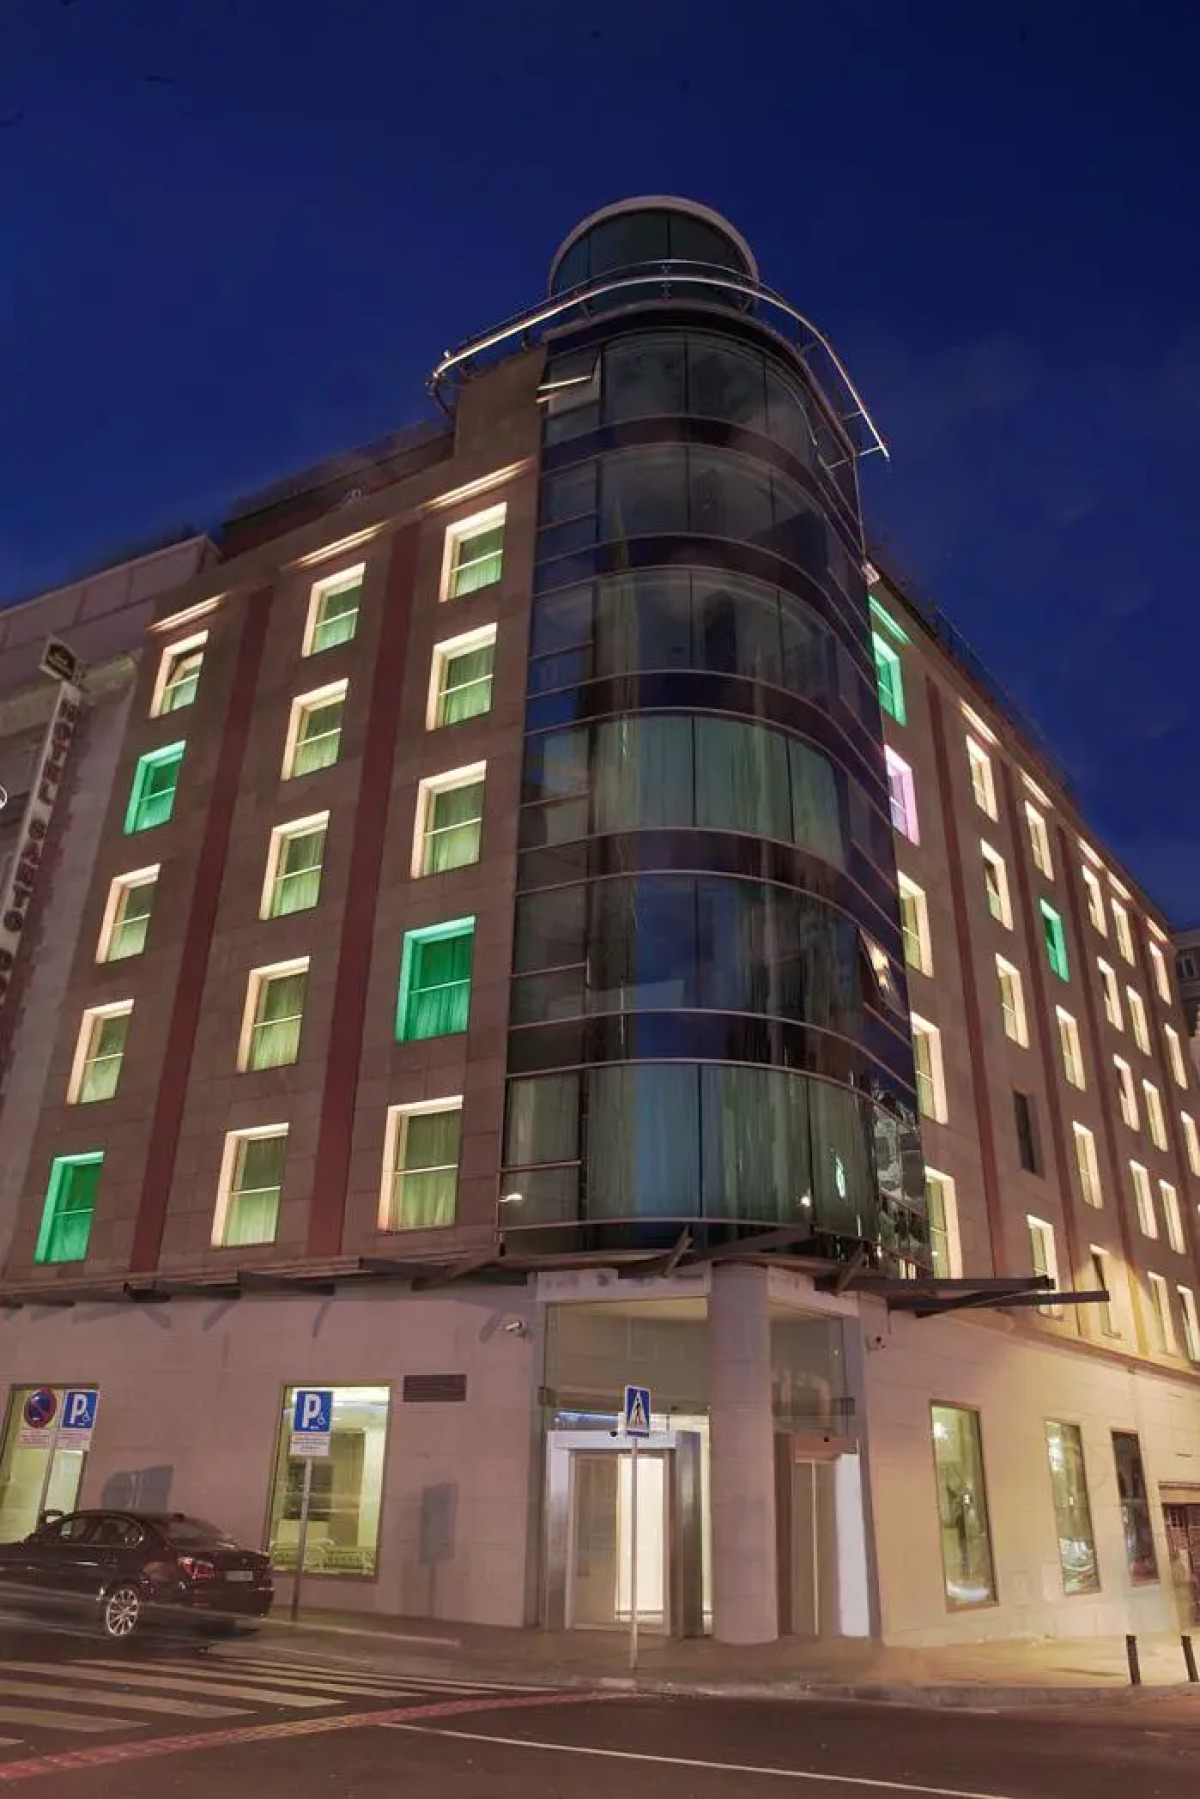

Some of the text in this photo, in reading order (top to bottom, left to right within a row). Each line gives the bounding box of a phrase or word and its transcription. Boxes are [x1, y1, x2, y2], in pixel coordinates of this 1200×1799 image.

[38, 698, 78, 805] HOTEL
[69, 1393, 87, 1423] P
[302, 1393, 322, 1428] P
